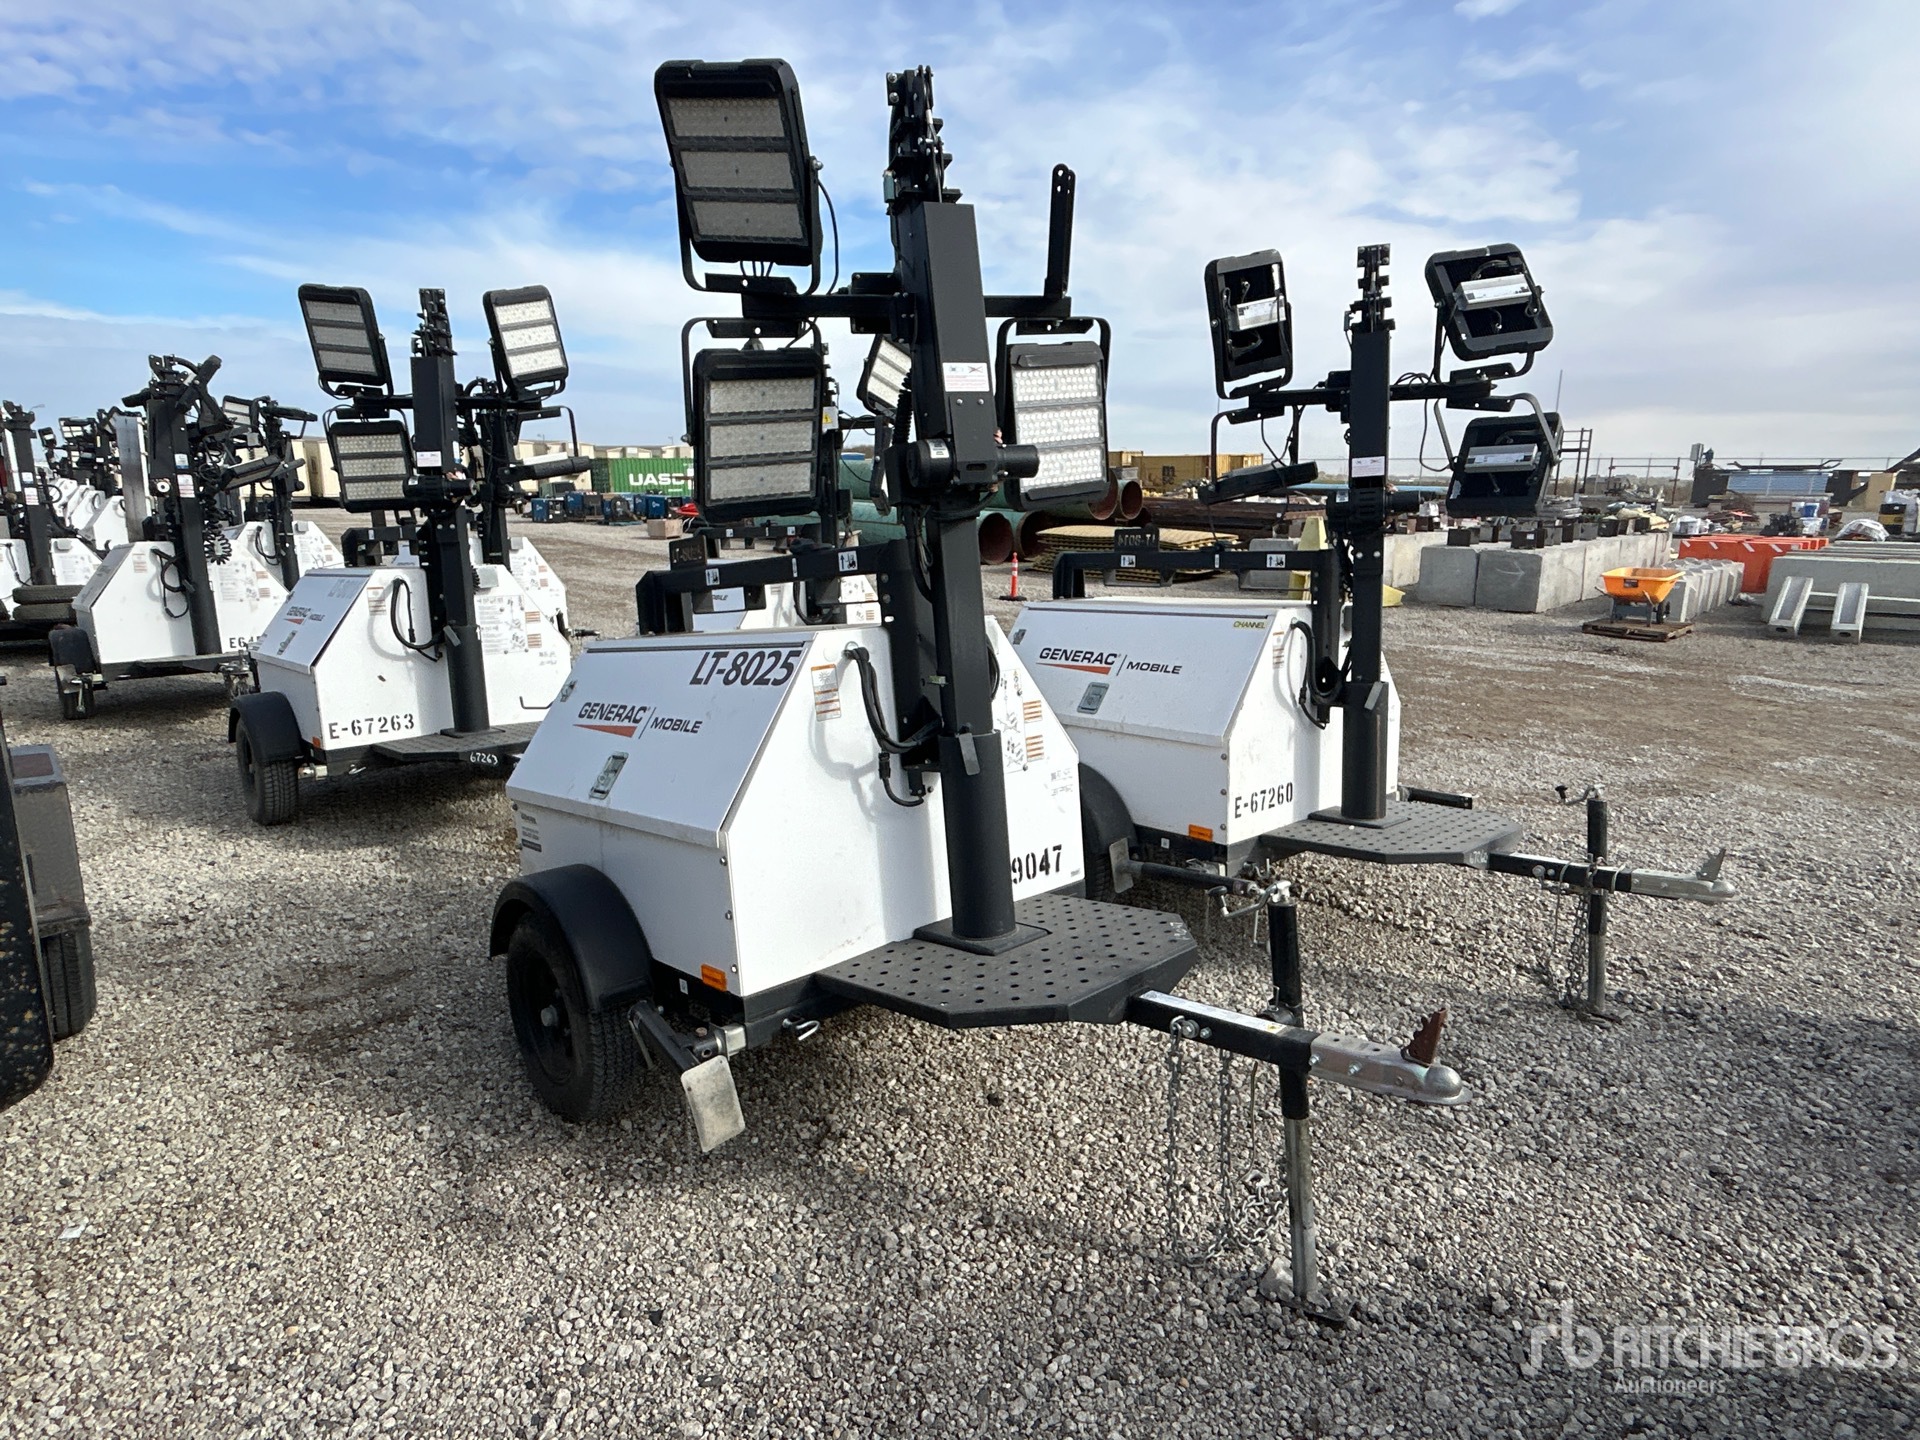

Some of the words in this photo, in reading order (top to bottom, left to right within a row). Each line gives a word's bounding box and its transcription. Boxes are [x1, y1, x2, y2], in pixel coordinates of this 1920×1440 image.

[628, 473, 685, 486] UASC
[1233, 620, 1266, 629] CHANNEL
[689, 649, 802, 686] LT-8025
[1039, 647, 1117, 666] GENERAC
[1126, 661, 1182, 675] MOBILE
[328, 713, 414, 739] E-67263
[578, 701, 648, 724] GENERAC
[650, 716, 703, 733] MOBILE
[469, 751, 498, 765] 67263
[1234, 781, 1293, 819] E-67260
[1011, 844, 1062, 884] 9047
